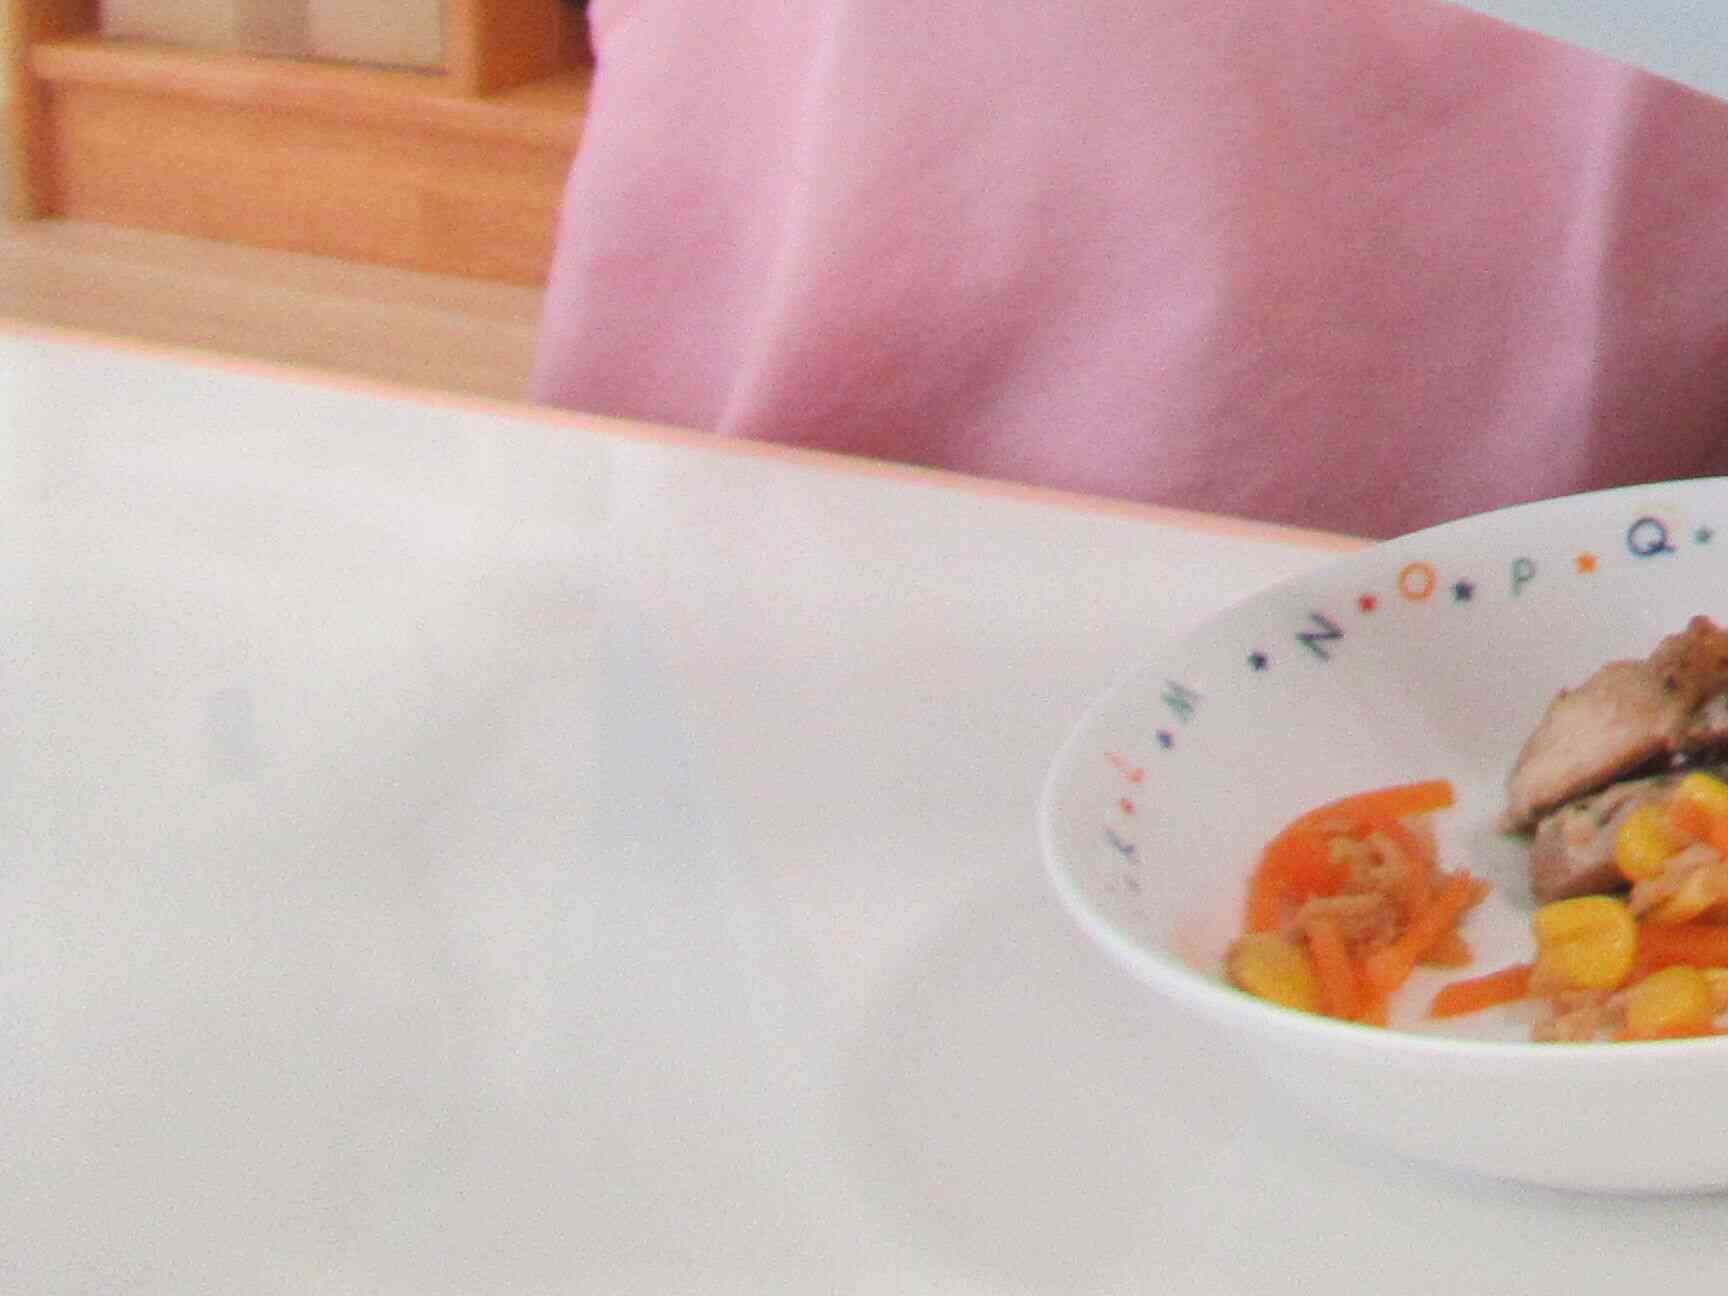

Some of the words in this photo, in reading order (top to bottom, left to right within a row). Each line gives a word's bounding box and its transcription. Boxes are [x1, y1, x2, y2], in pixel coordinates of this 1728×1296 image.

[1296, 611, 1344, 663] N
[1508, 557, 1537, 597] P
[1625, 515, 1677, 558] Q
